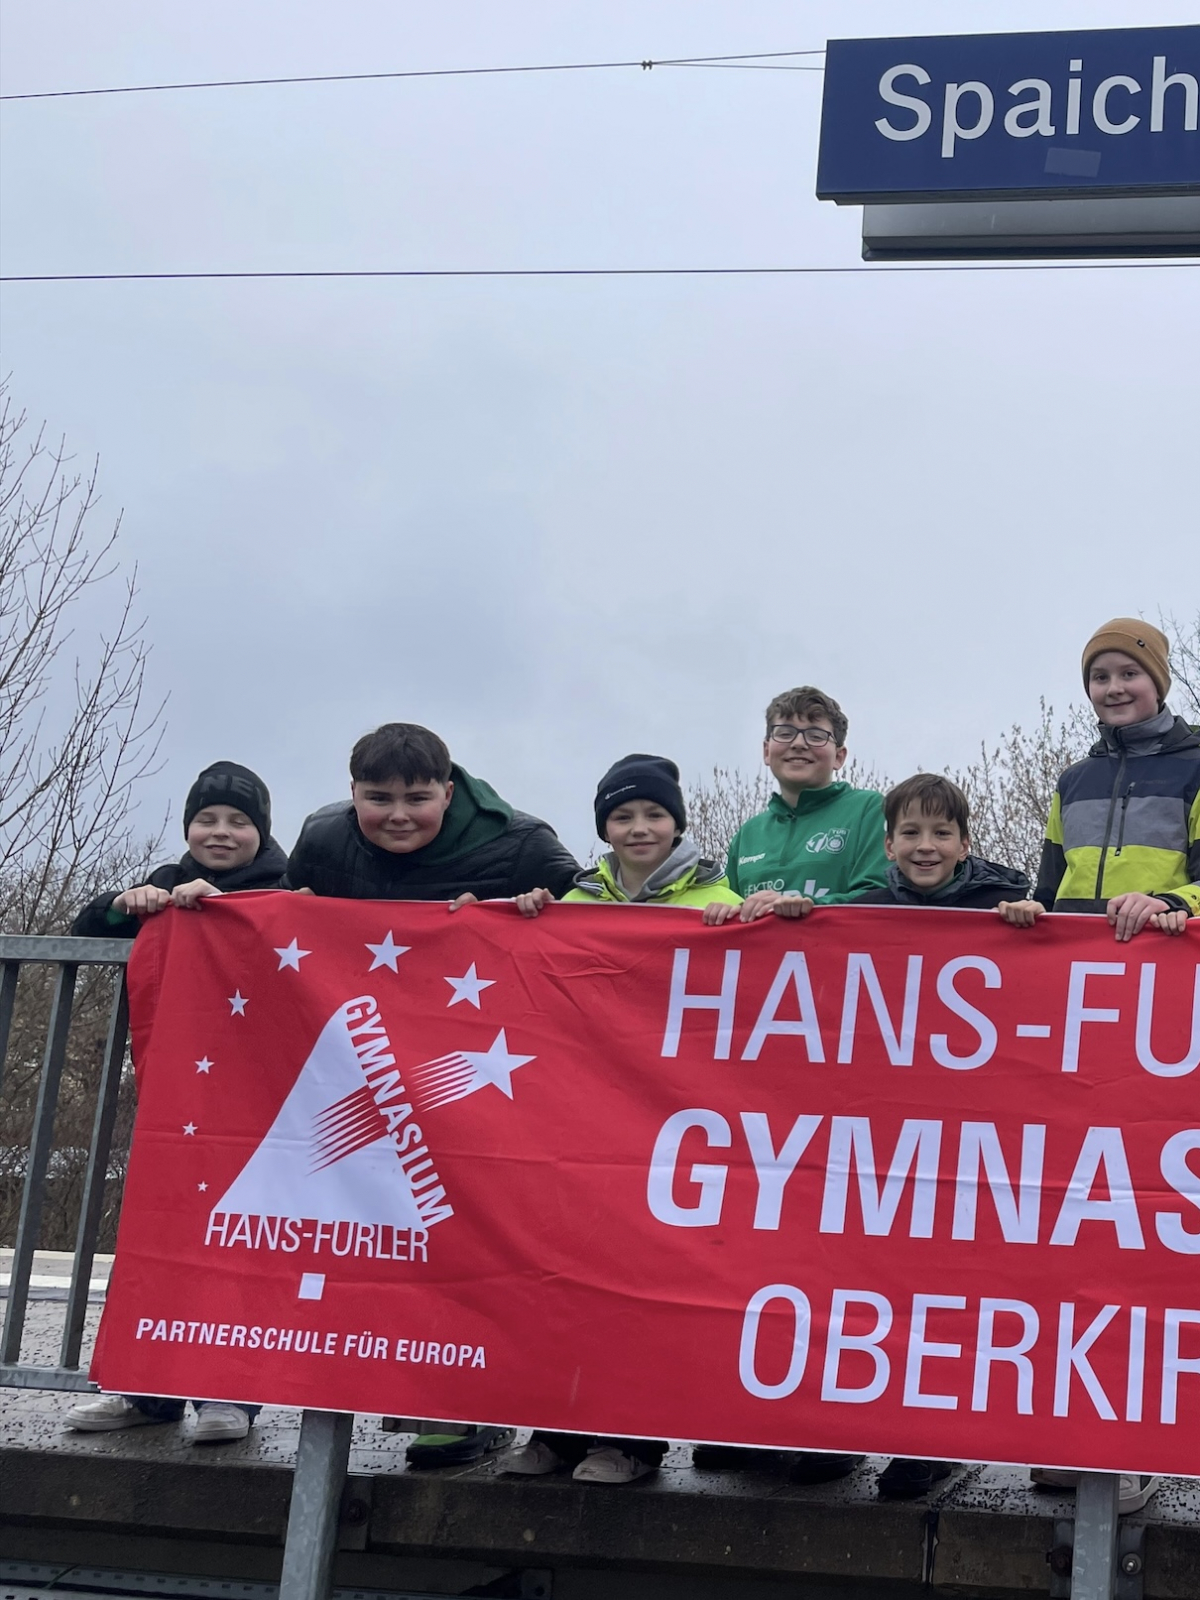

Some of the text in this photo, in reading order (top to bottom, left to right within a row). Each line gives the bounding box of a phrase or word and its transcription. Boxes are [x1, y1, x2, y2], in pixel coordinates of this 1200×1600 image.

[343, 994, 455, 1230] GYMNASIUM
[204, 1210, 429, 1263] HANS-FURLER
[135, 1317, 487, 1370] PARTNERSCHULE FÜR EUROPA
